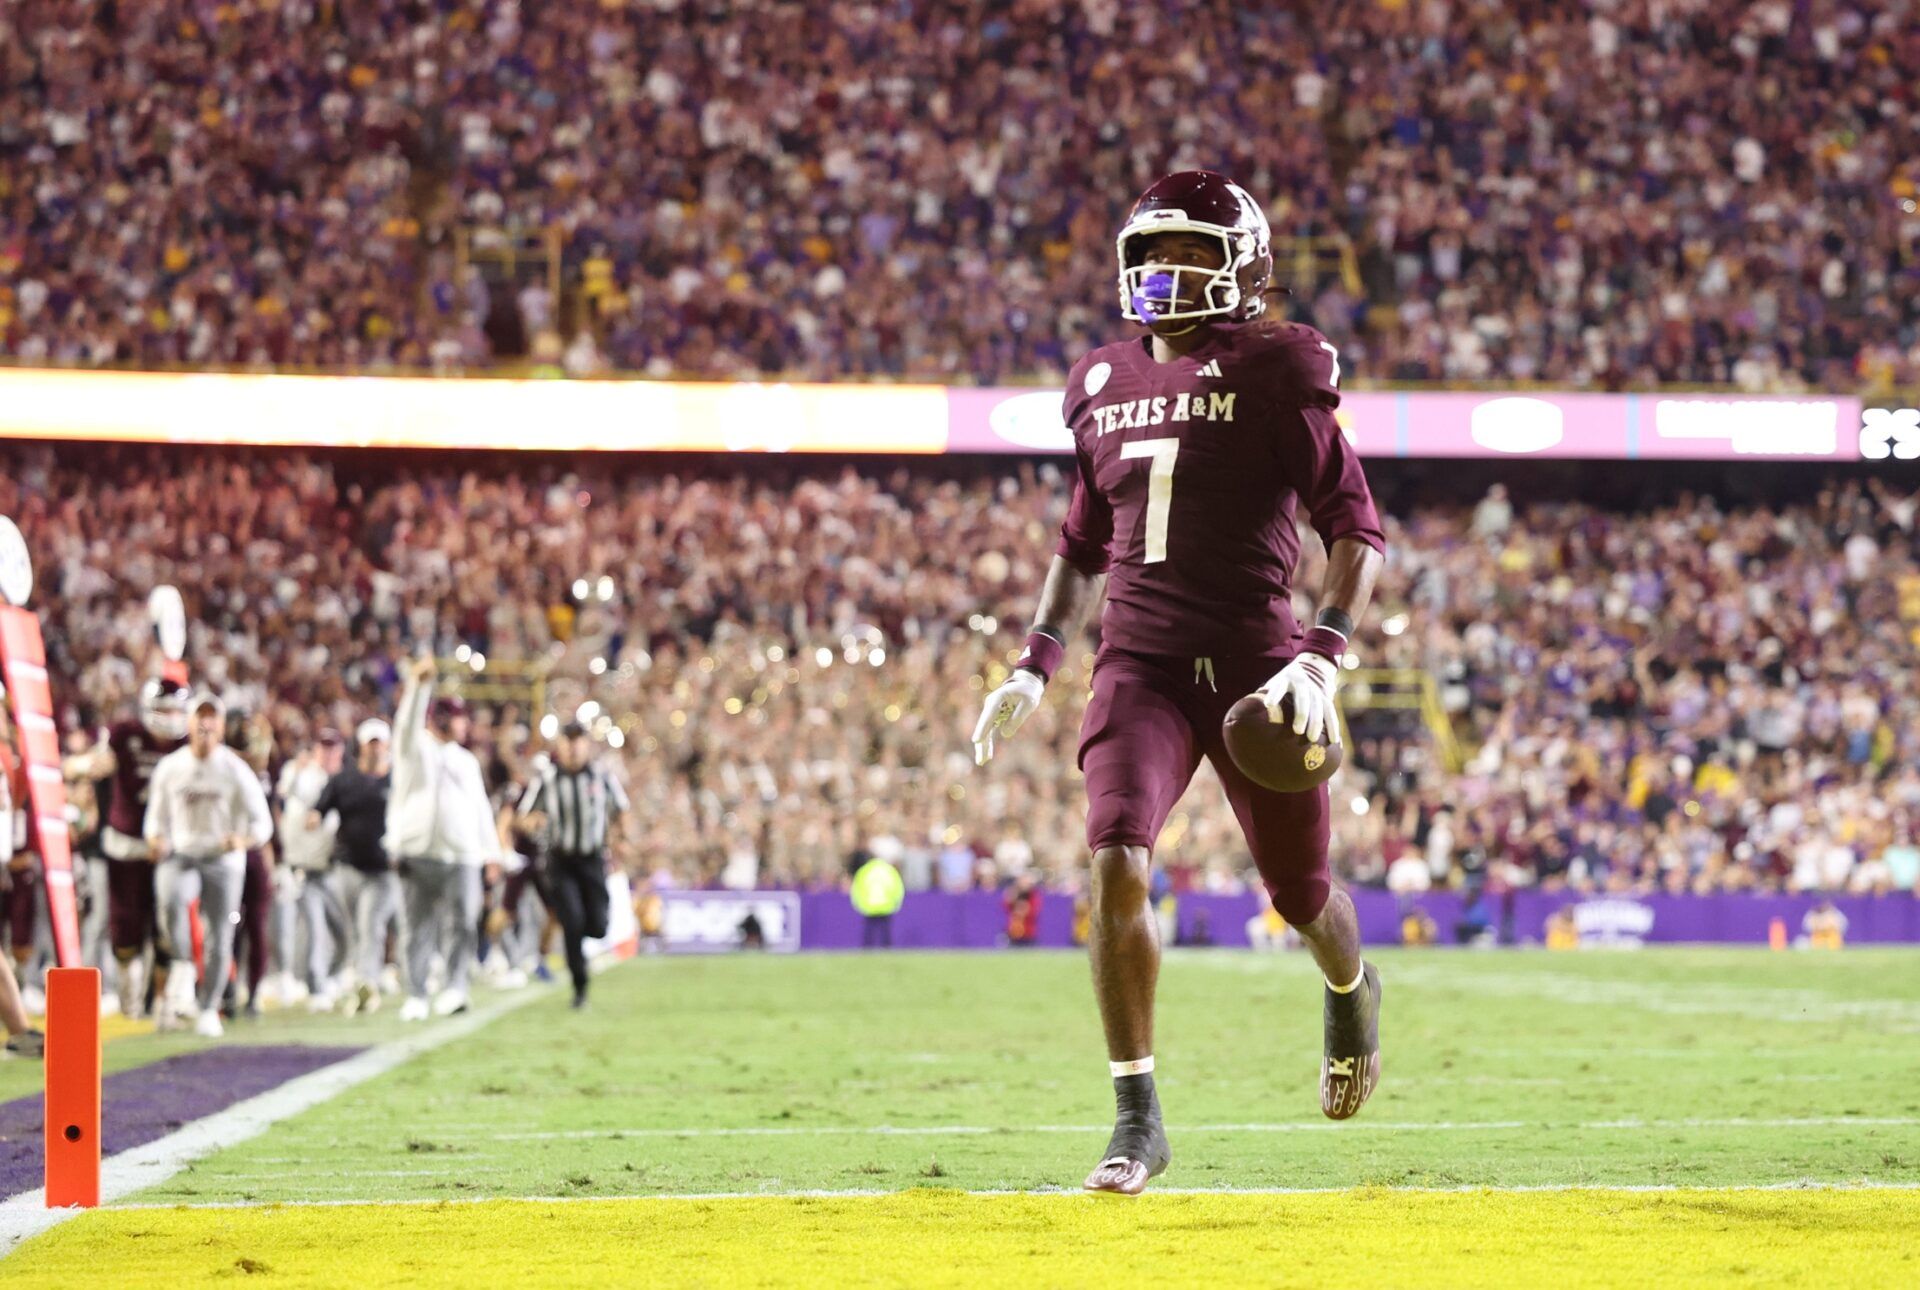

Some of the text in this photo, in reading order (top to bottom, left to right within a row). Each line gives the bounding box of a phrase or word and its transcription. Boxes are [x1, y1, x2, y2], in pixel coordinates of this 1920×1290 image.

[1092, 392, 1236, 437] TEXAS A&M
[1120, 437, 1180, 564] 7
